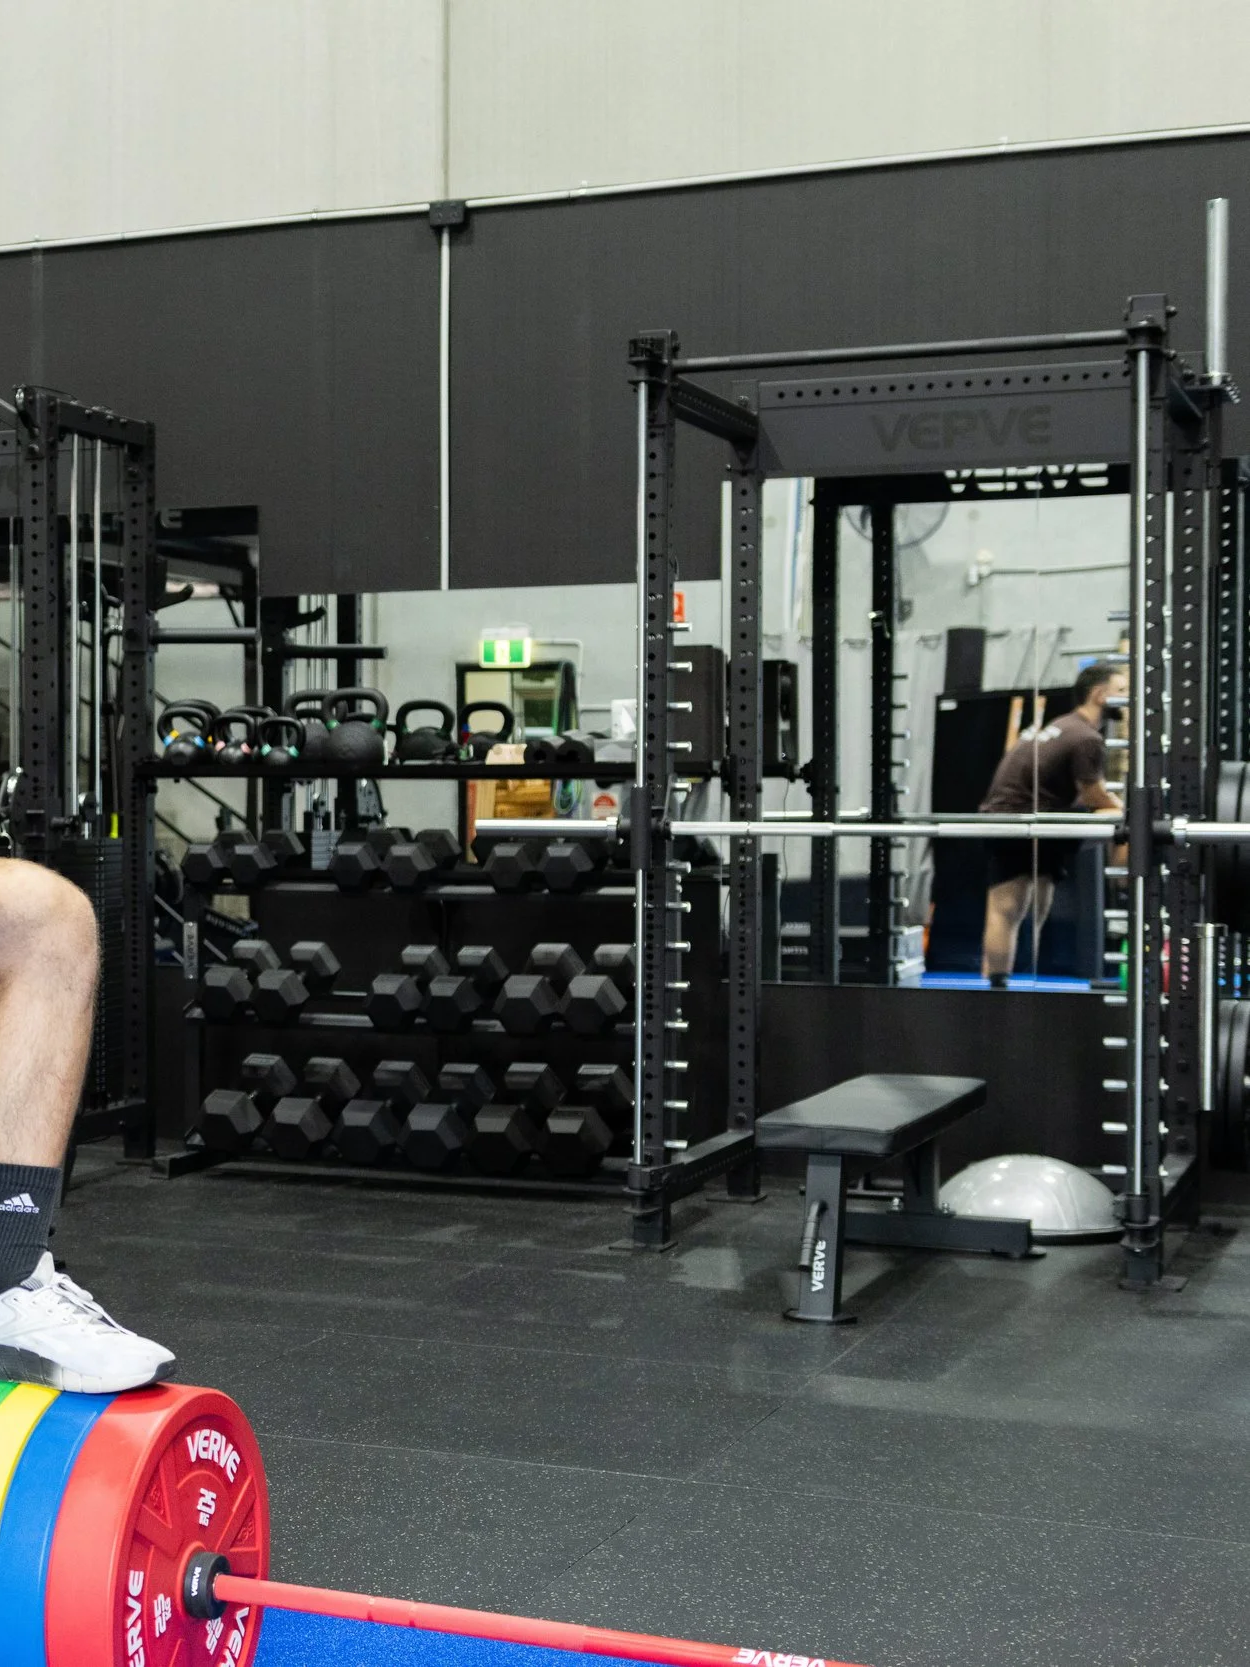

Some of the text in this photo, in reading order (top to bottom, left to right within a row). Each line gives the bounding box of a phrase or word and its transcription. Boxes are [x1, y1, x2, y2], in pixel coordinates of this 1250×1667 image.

[810, 1239, 827, 1292] VERVE
[185, 1428, 241, 1483] VERVE
[190, 1566, 202, 1597] VERVE
[127, 1569, 145, 1667] ERVE
